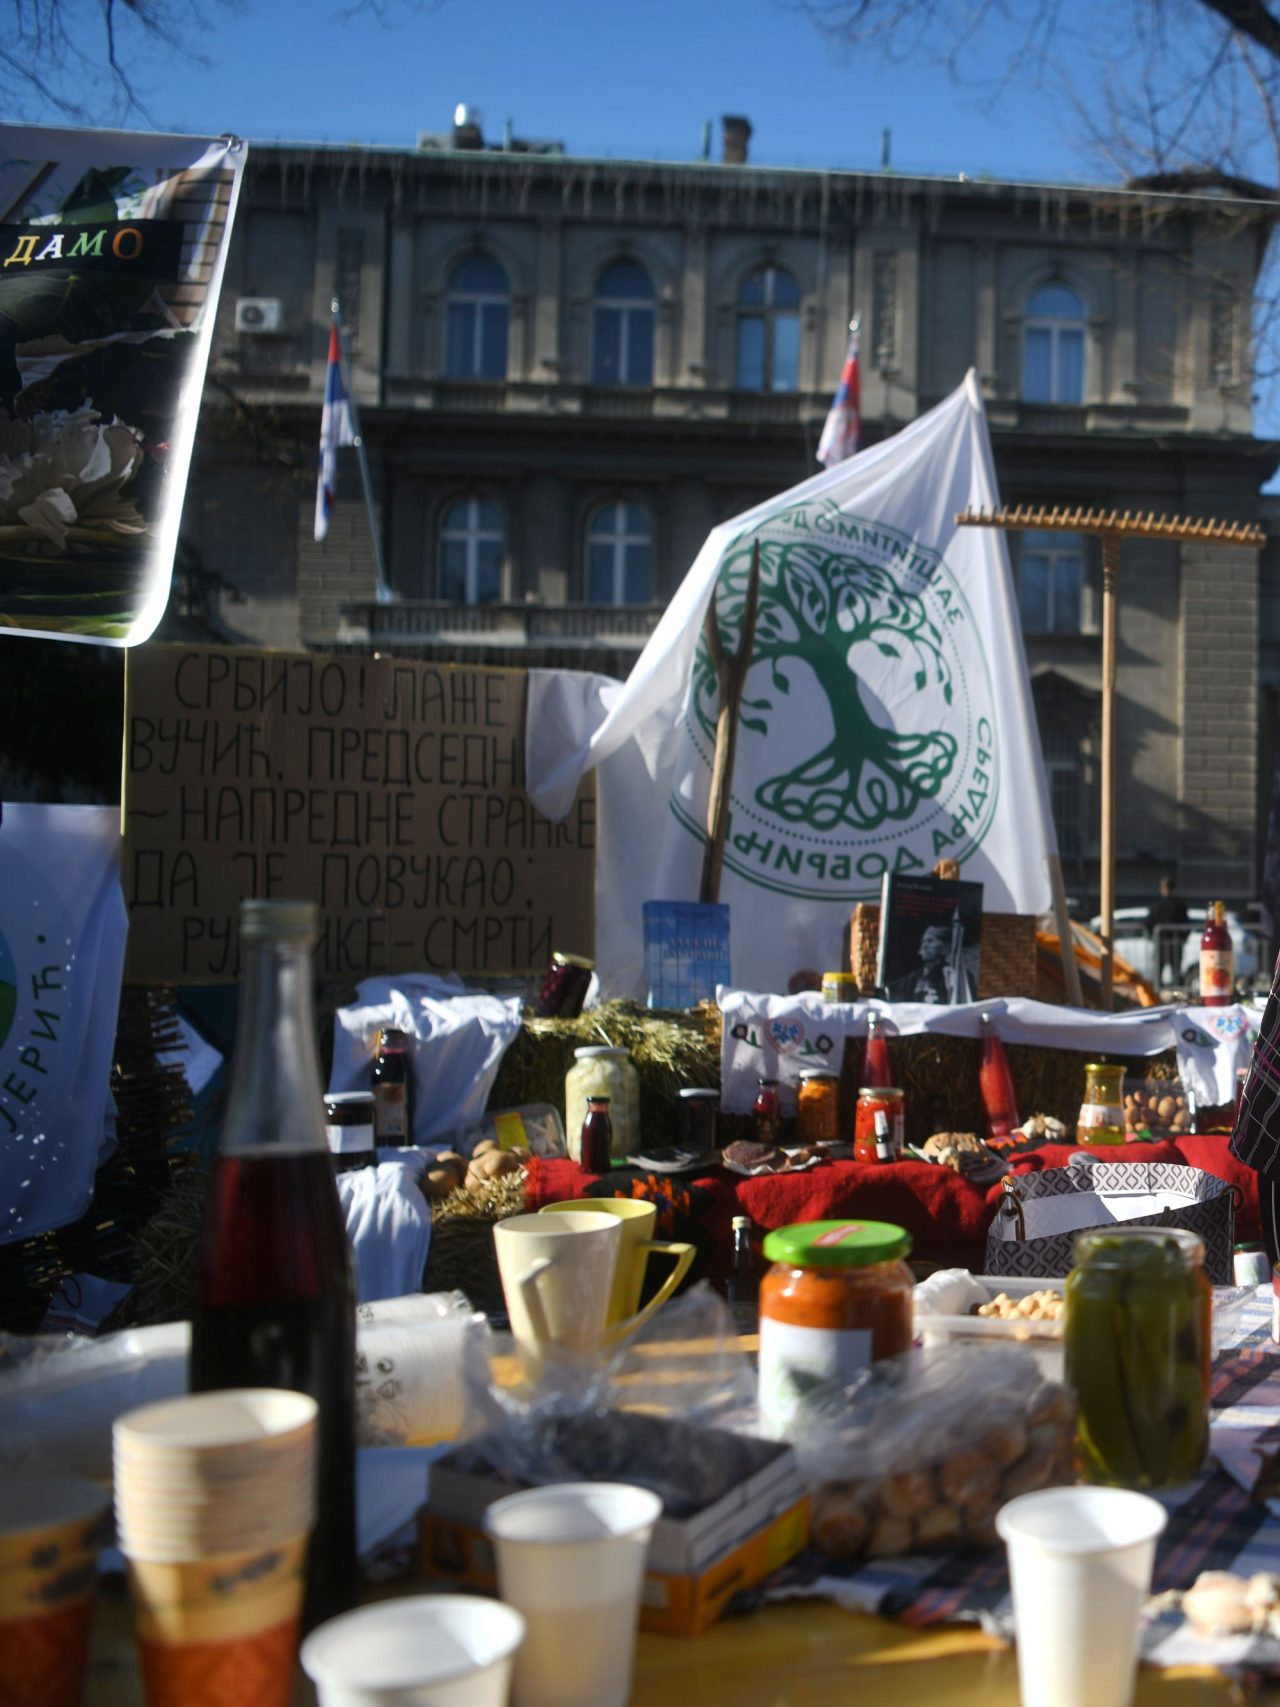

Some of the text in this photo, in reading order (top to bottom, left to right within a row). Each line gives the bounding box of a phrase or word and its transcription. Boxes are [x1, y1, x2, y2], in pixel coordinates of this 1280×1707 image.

[4, 227, 144, 267] ДАМО
[174, 652, 506, 727] СРБИЈО! ЛАЖЕ
[129, 850, 199, 910] ДА
